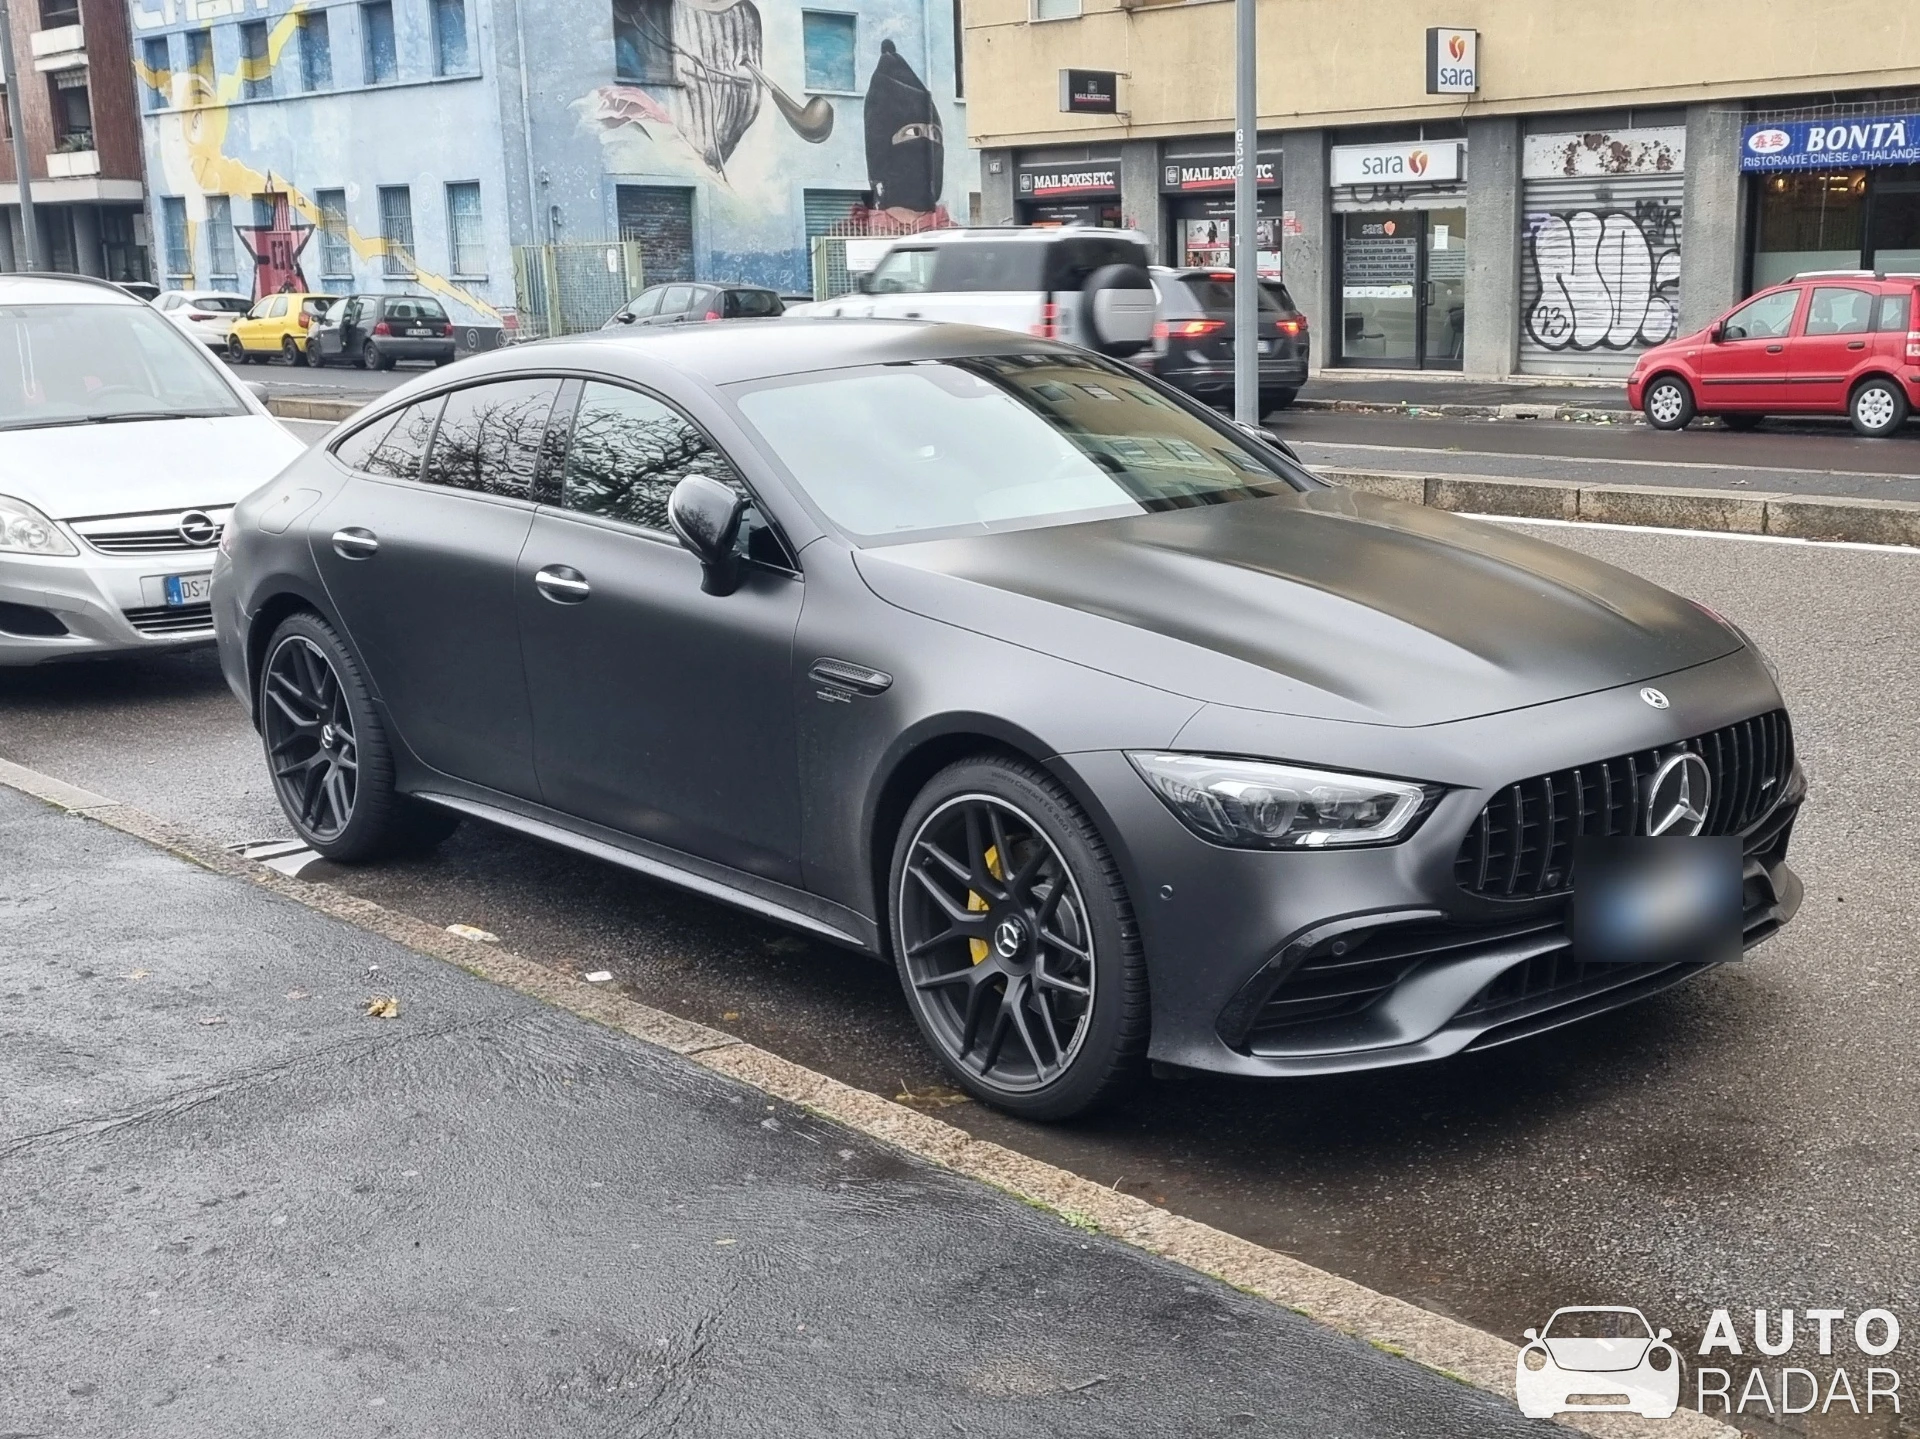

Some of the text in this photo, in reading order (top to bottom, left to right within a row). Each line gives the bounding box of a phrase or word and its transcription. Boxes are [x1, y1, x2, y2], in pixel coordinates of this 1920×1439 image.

[1440, 68, 1473, 86] sara
[1806, 120, 1906, 152] BONTÀ
[1362, 155, 1403, 175] sara
[1744, 154, 1808, 167] RISTORANTE
[1811, 152, 1849, 164] CINESE
[1034, 175, 1061, 188] MAIL
[1062, 173, 1093, 187] BOXES
[1182, 167, 1212, 181] MAIL
[1213, 166, 1237, 180] BOX
[1256, 164, 1273, 178] TC.
[1362, 224, 1384, 234] sara
